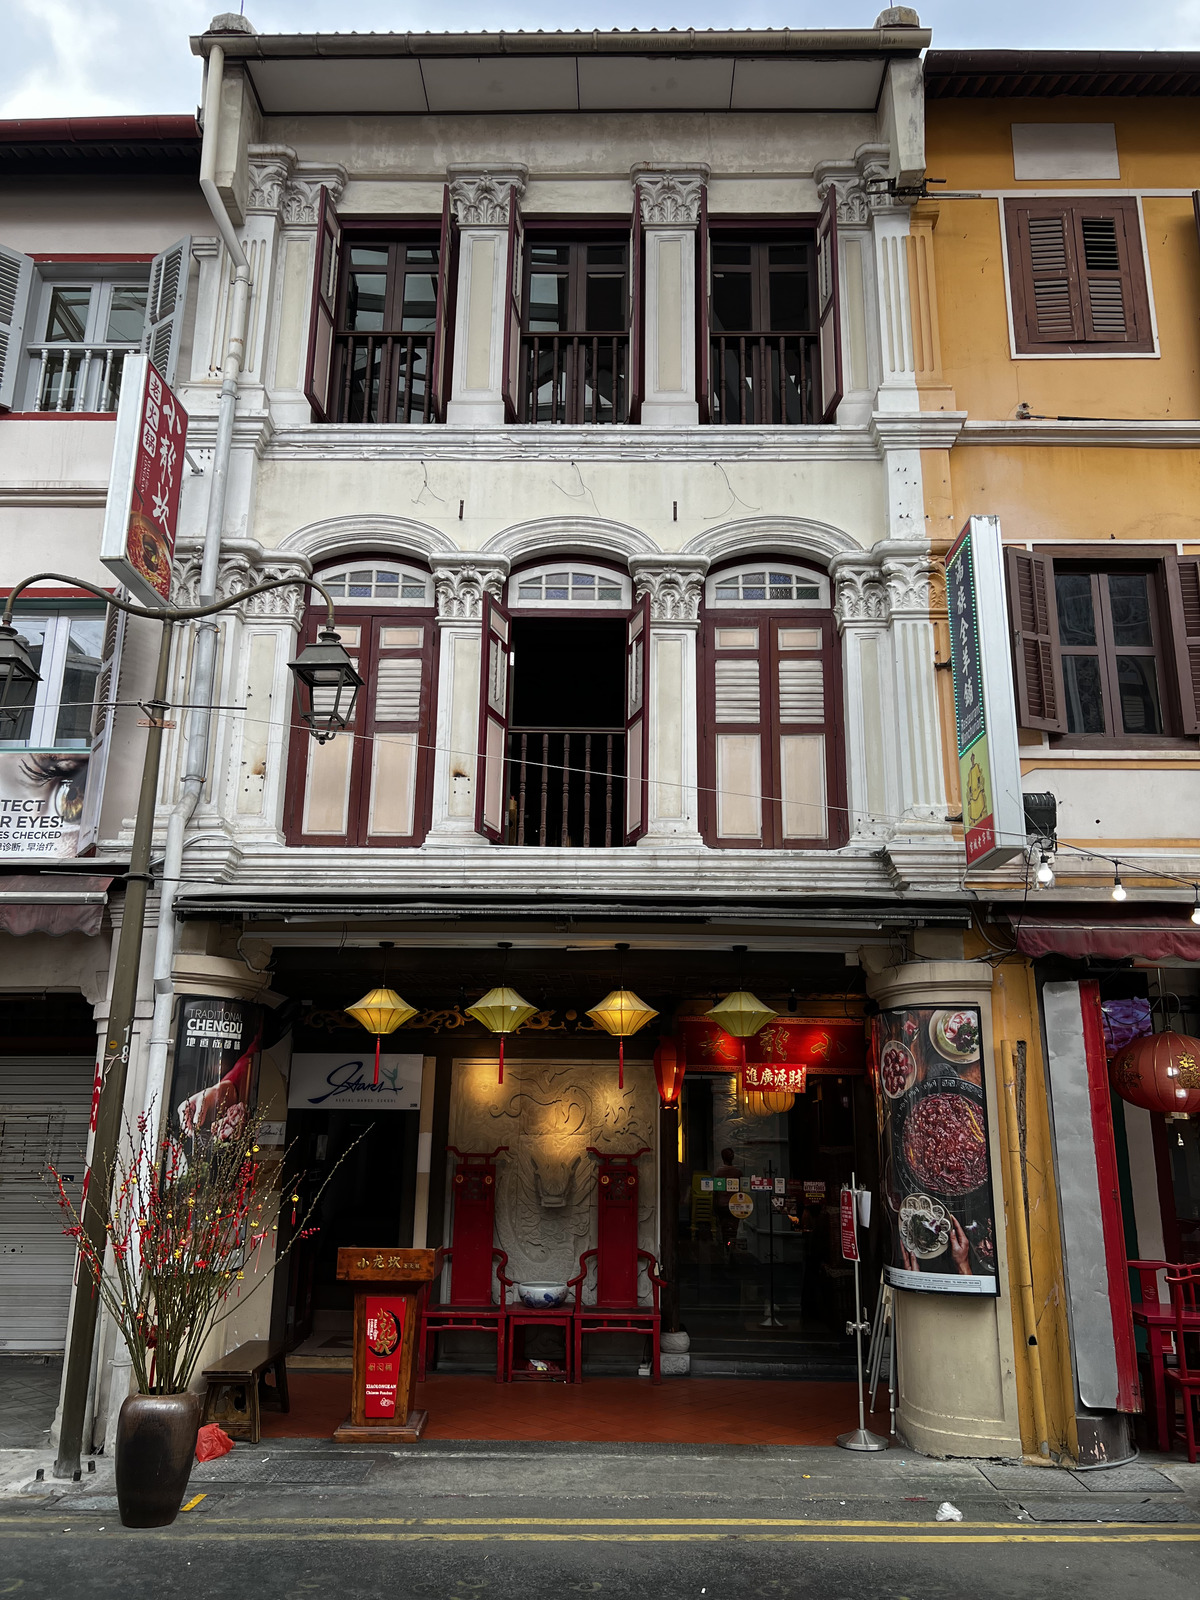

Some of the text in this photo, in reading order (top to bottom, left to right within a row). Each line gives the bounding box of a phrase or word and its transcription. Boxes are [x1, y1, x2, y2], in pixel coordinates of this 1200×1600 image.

[17, 816, 64, 828] EYES!
[12, 831, 62, 839] CHECKED
[0, 842, 58, 852] 诊断。早治疗。
[189, 1008, 243, 1022] TRADITIONAL
[187, 1018, 243, 1034] CHENGDU
[746, 1066, 803, 1087] 財源廣進
[357, 1254, 401, 1269] 小龙坎
